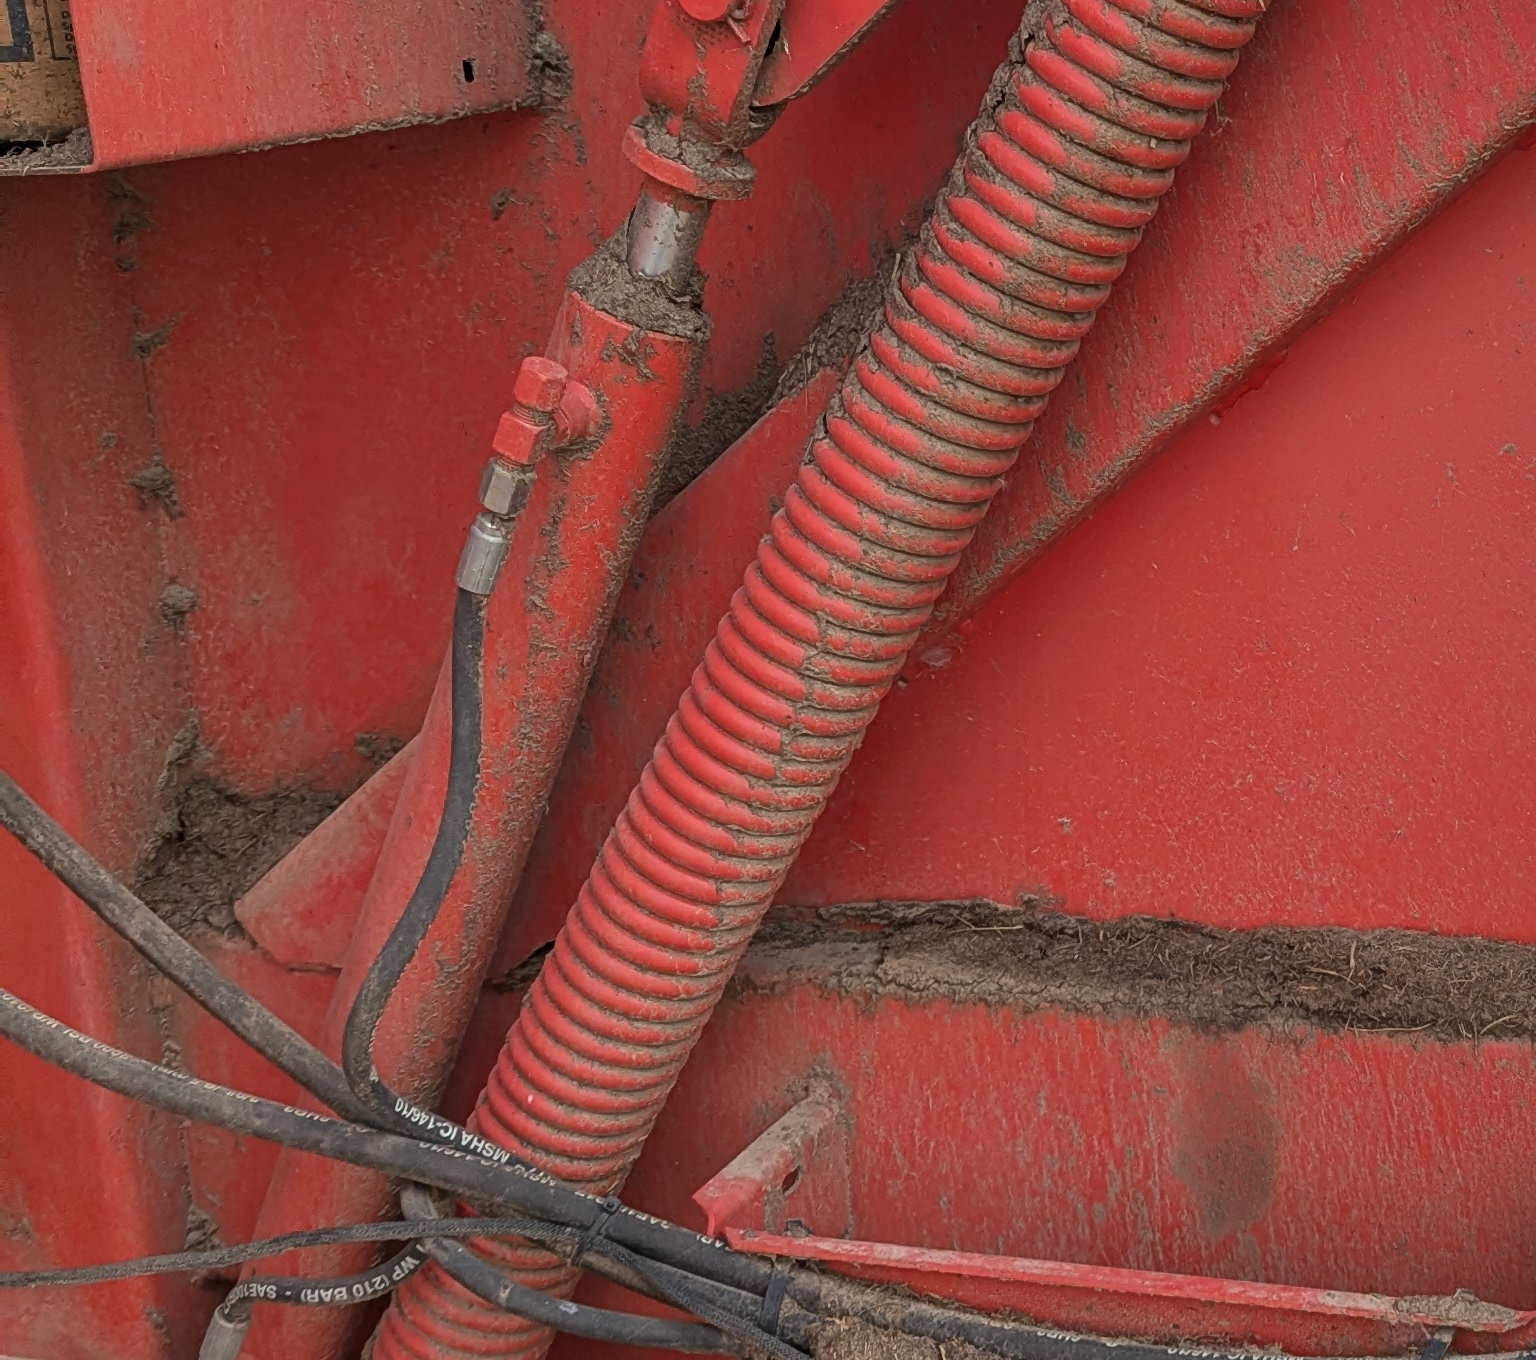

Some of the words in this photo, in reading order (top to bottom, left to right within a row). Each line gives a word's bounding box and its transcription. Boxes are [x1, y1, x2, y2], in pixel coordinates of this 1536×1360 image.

[394, 1097, 458, 1142] IC-146/10
[461, 1129, 511, 1164] MSHA
[391, 1255, 420, 1282] WP
[301, 1285, 349, 1303] BAR)
[352, 1276, 391, 1298] (210
